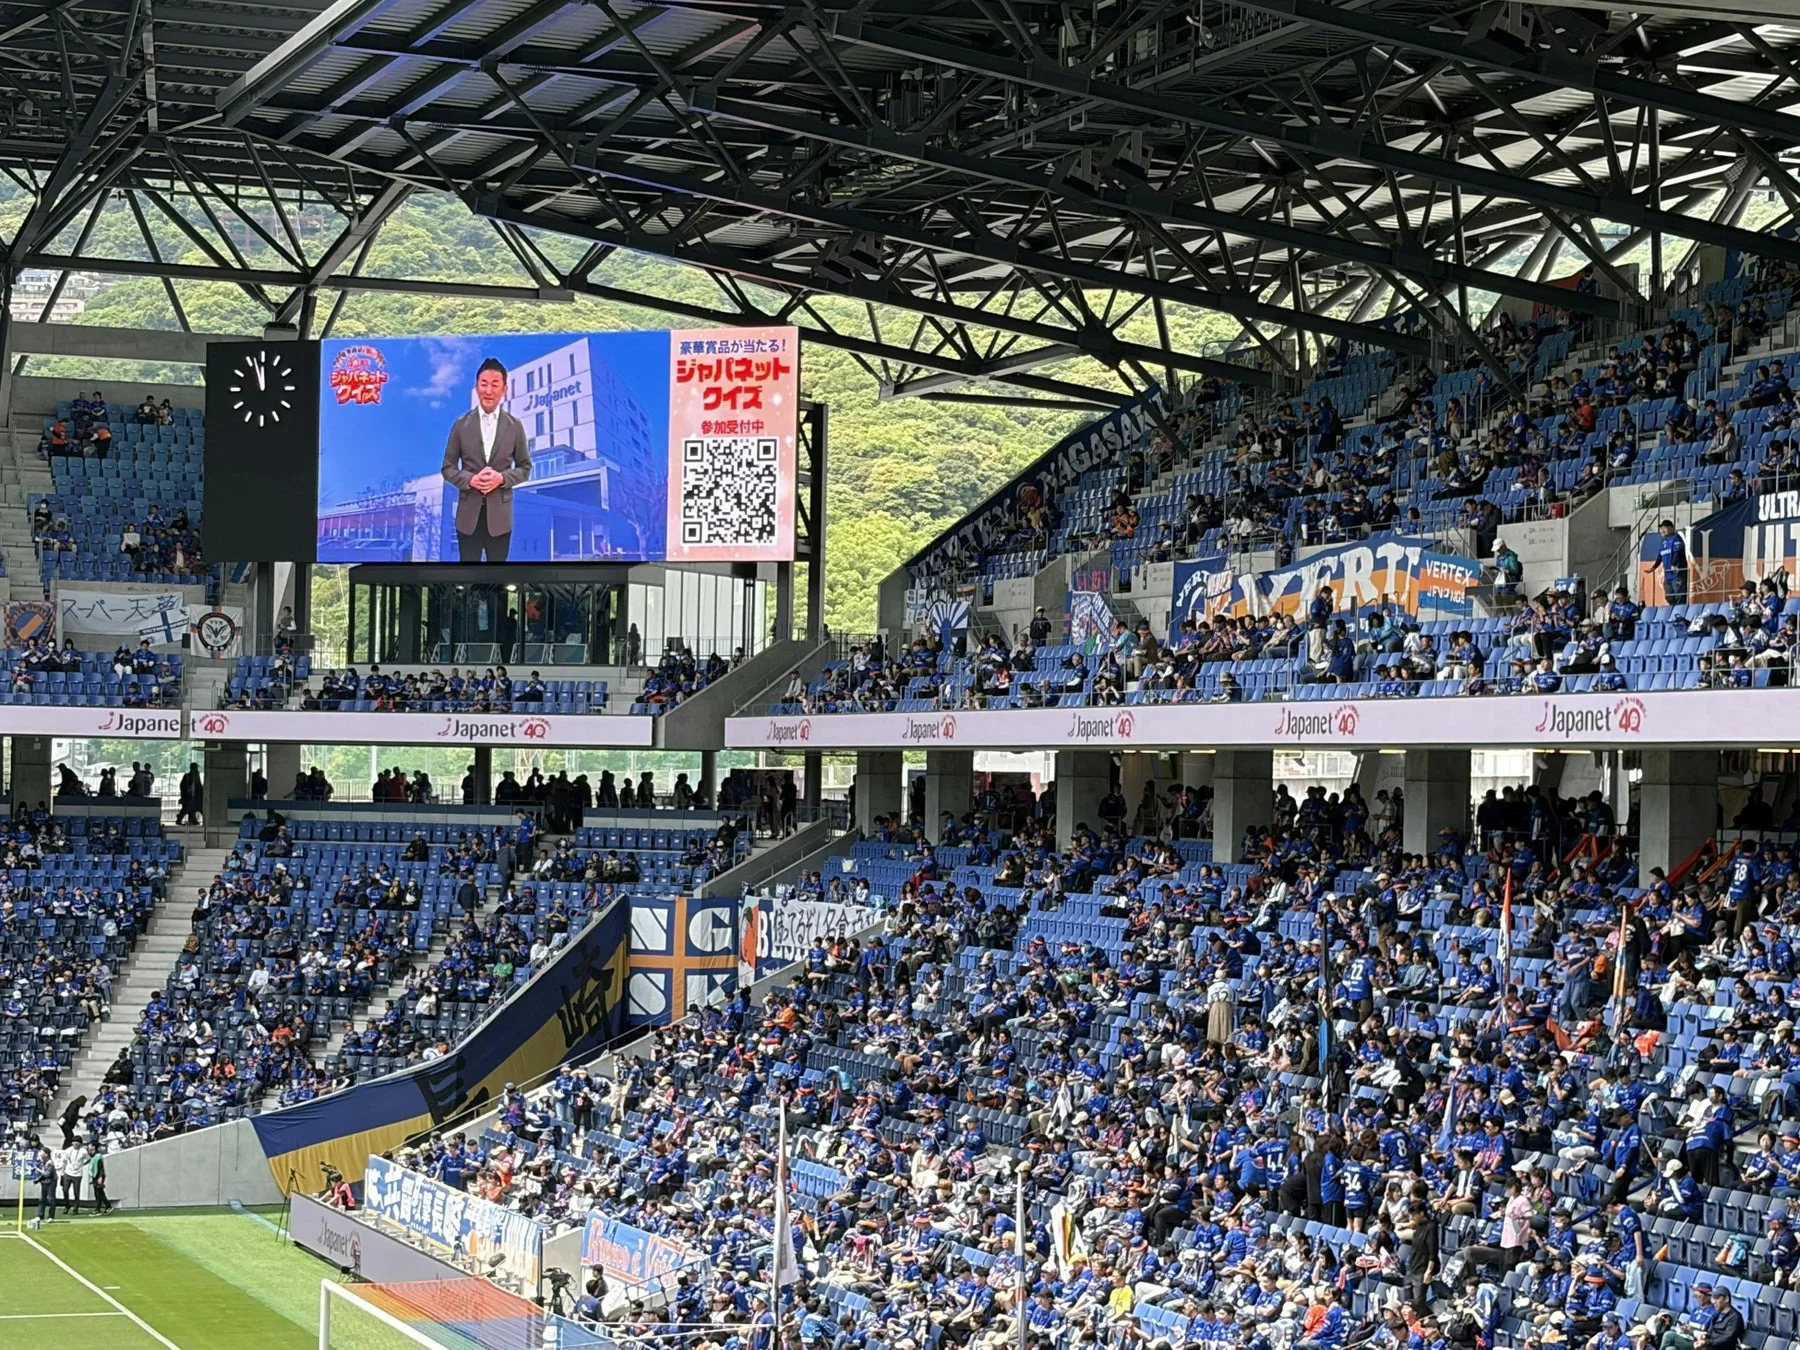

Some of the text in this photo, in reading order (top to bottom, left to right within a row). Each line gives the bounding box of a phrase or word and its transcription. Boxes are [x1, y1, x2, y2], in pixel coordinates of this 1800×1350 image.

[330, 369, 389, 388] ジャパネット
[676, 357, 790, 382] ジャパネット
[336, 383, 382, 404] クイズ
[533, 380, 582, 408] Japanet
[703, 385, 763, 410] クイズ
[701, 420, 764, 435] 参加受付中
[1425, 559, 1473, 587] VERTEX
[452, 719, 516, 740] Japanet
[772, 722, 798, 743] Japanet
[909, 719, 940, 744] Japanet
[1076, 715, 1113, 742] Japanet
[1284, 709, 1333, 740] Japanet
[1549, 703, 1612, 739] Japanet
[1396, 1138, 1408, 1157] 8
[1343, 1172, 1361, 1192] 34
